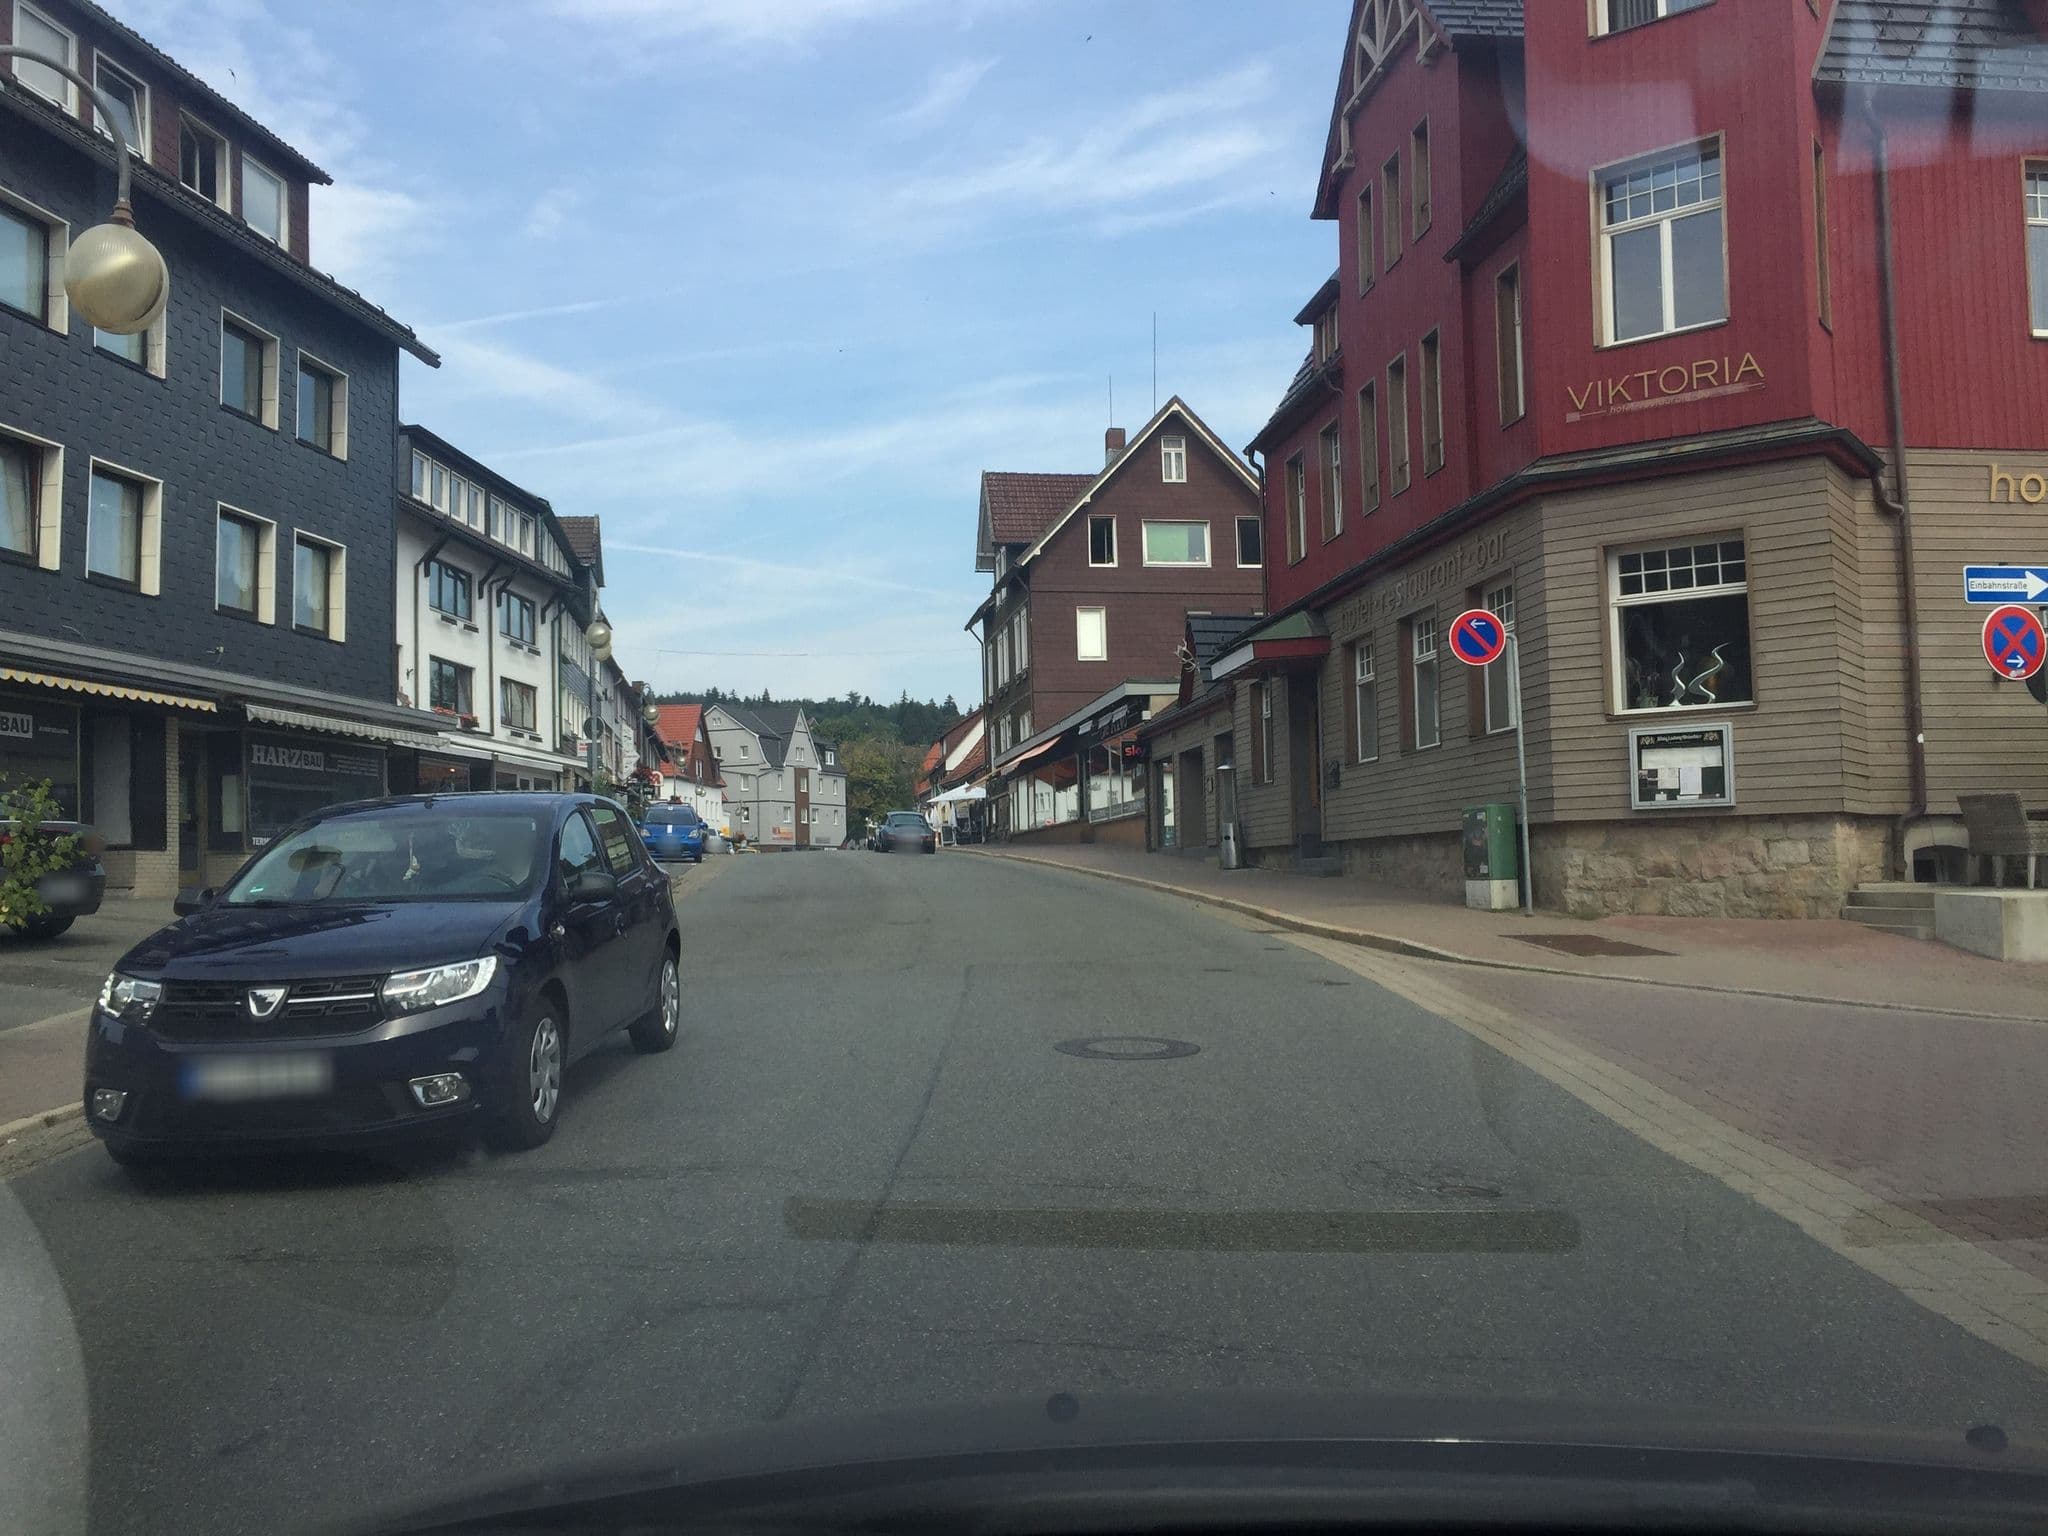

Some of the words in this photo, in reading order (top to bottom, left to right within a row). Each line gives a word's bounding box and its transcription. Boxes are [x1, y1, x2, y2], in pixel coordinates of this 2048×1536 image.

[1566, 351, 1765, 411] VIKTORIA
[1989, 463, 2047, 504] ho
[1379, 543, 1464, 616] restaurant
[1476, 530, 1509, 569] bar
[1969, 580, 2028, 591] Einbahnstraße
[0, 716, 30, 735] BAU
